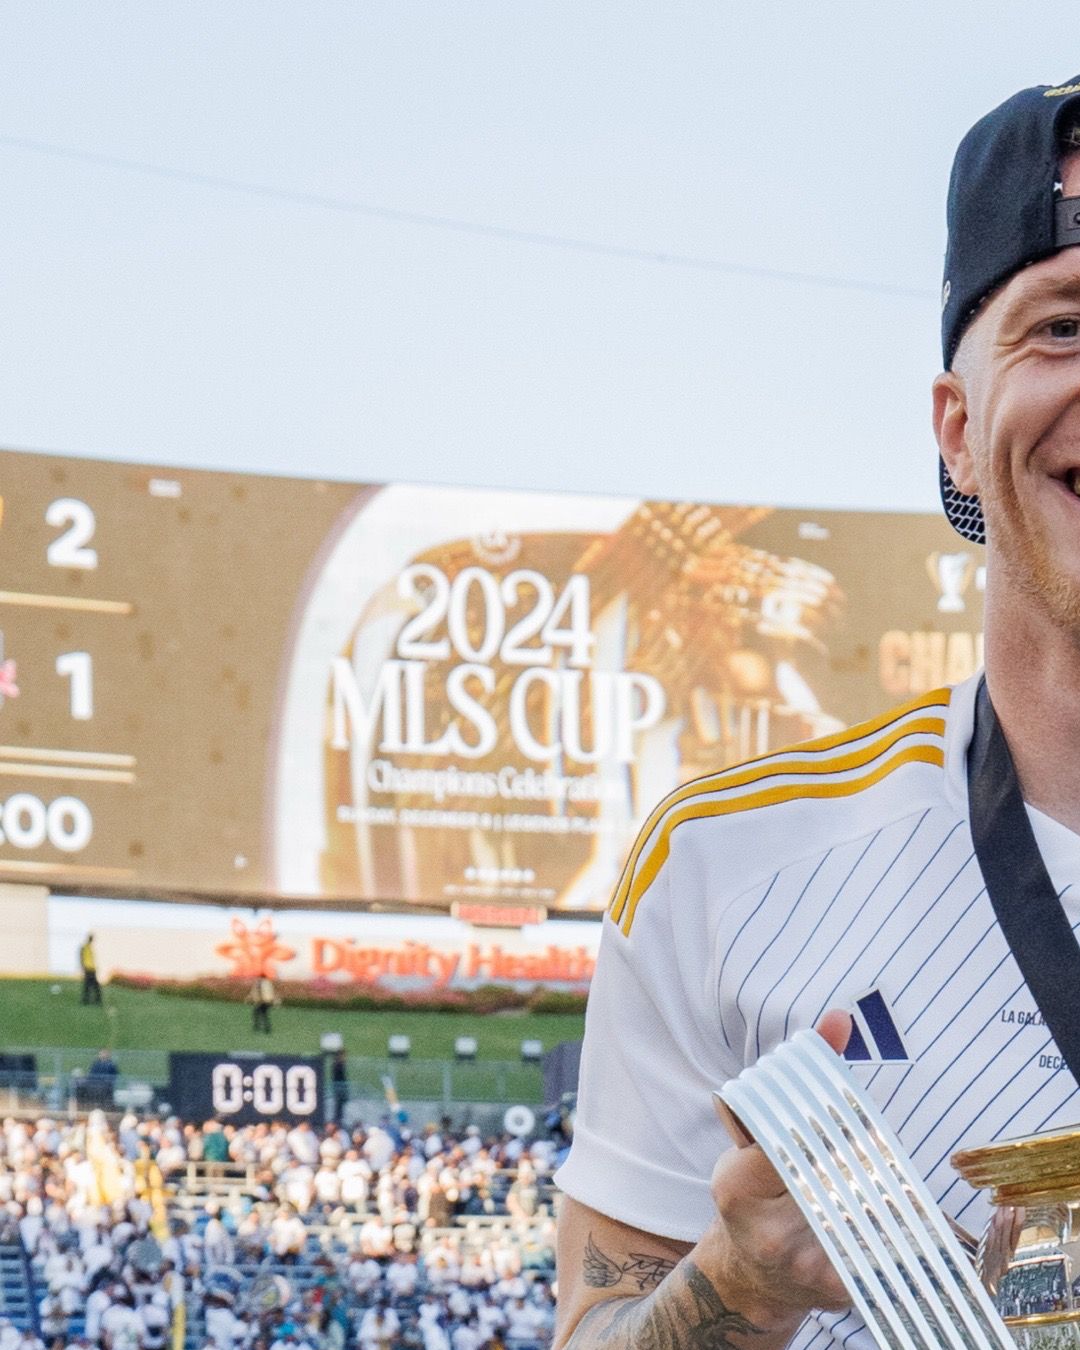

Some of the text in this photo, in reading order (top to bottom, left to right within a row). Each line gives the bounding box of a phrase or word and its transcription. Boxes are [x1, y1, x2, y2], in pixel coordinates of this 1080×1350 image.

[45, 498, 98, 570] 2
[396, 563, 597, 667] 2024
[56, 651, 93, 720] 1
[879, 630, 987, 696] CHA
[331, 655, 667, 764] MLS CUP
[367, 759, 498, 803] Champions
[313, 937, 597, 988] Dignity Health
[1001, 1009, 1015, 1023] LA
[1018, 1011, 1048, 1027] GALA
[212, 1064, 317, 1116] 0:00
[1039, 1054, 1069, 1070] DECE
